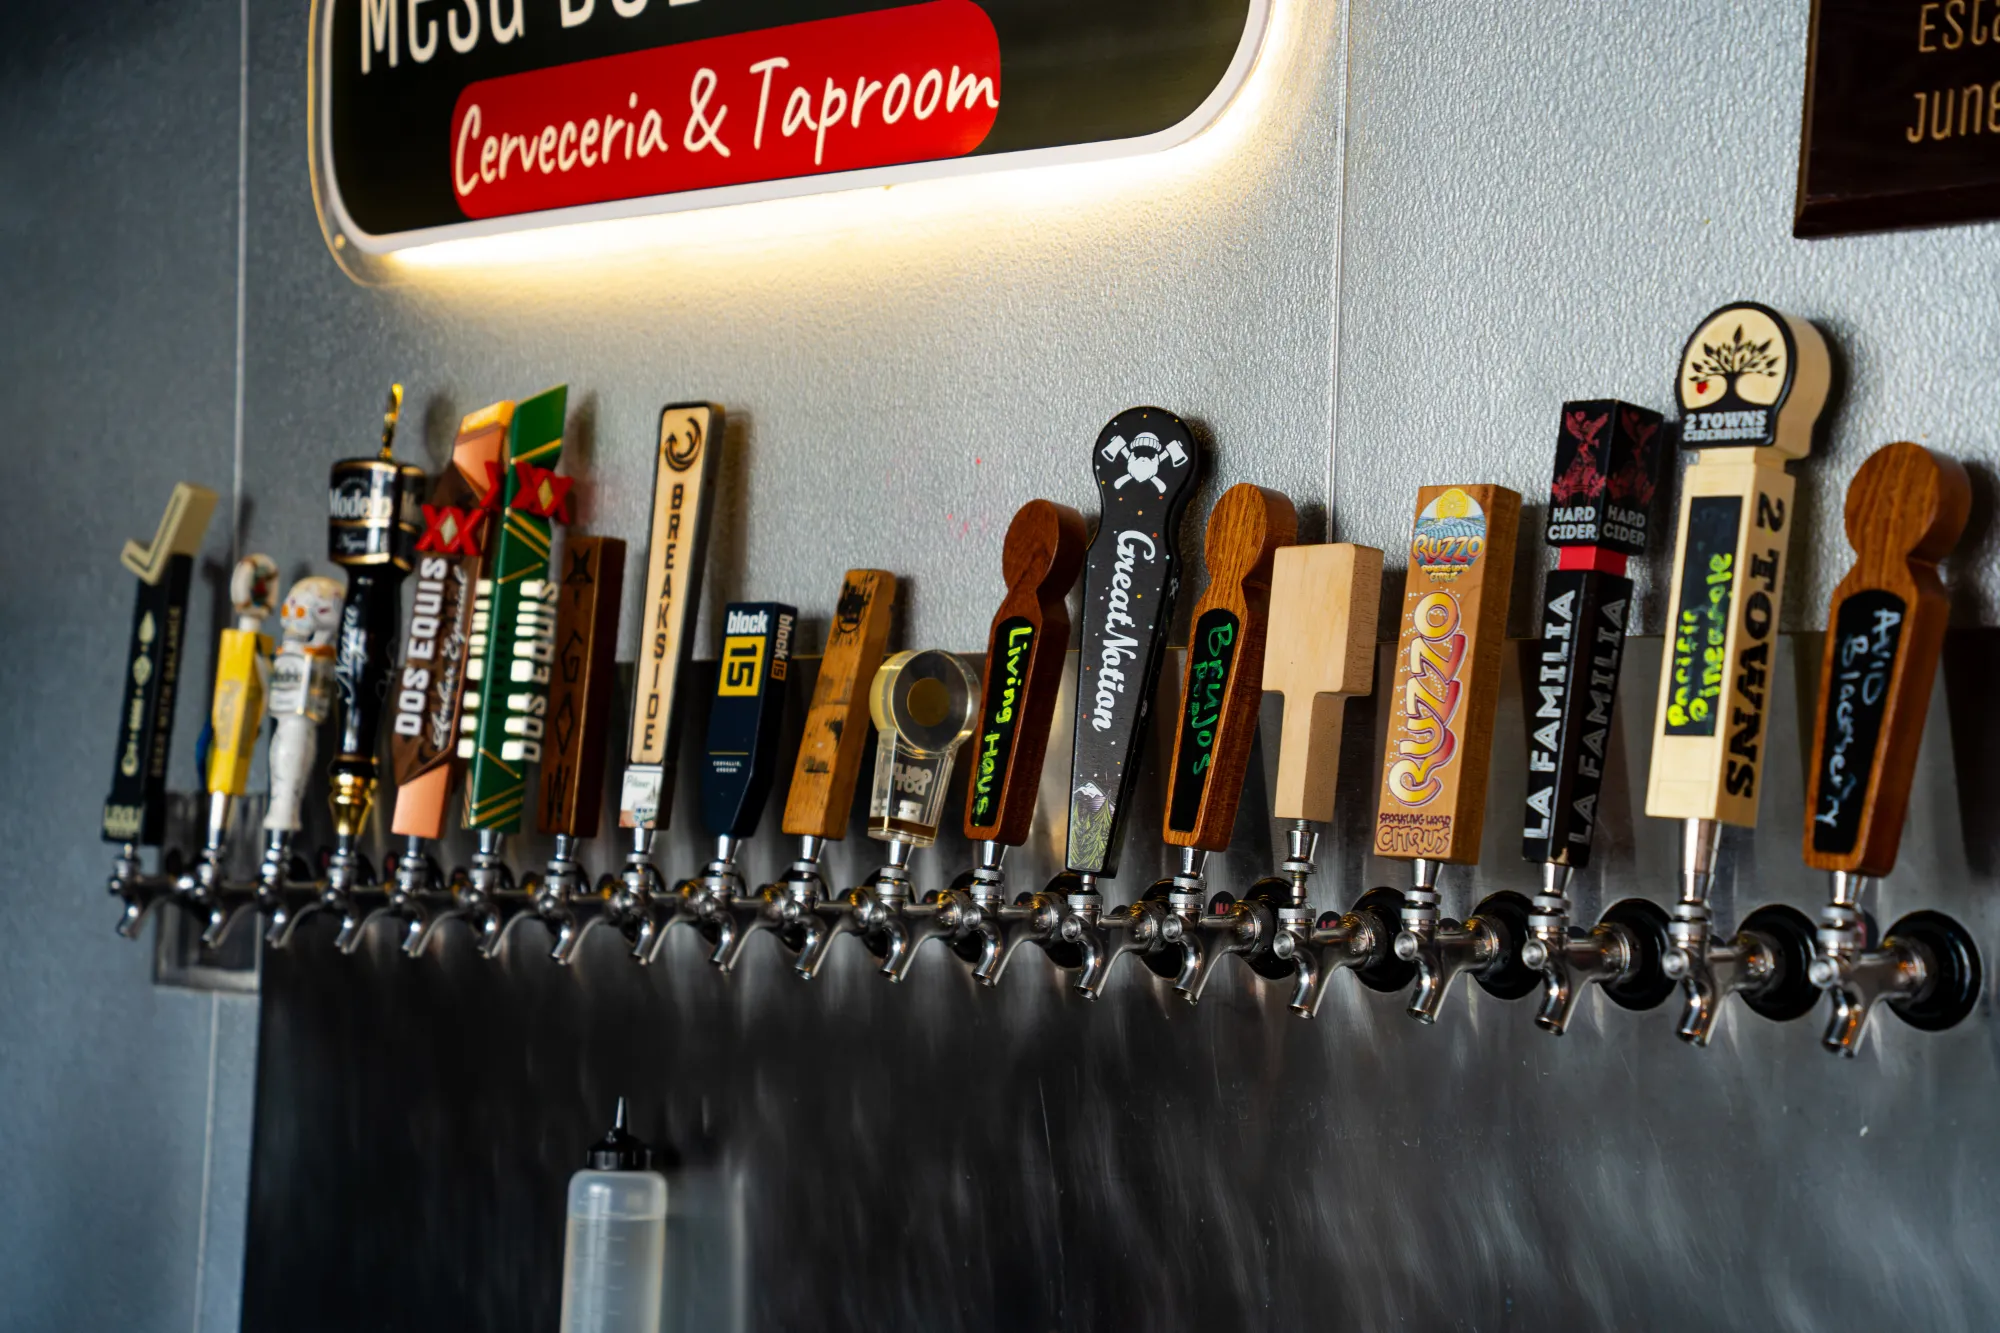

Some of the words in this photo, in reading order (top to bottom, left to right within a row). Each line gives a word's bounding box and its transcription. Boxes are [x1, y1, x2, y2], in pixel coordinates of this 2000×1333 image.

[455, 92, 669, 197] Cerveceria
[683, 68, 731, 158] &
[750, 57, 999, 166] Taproom
[1684, 413, 1697, 430] 2
[1698, 410, 1768, 429] TOWNS
[1548, 523, 1596, 541] CIDER
[1552, 506, 1596, 523] HARD
[1602, 523, 1645, 547] CIDER
[1607, 507, 1646, 527] HARD
[1755, 491, 1785, 532] 2
[1412, 533, 1485, 564] RUZZO
[407, 557, 448, 660] EQUIS
[643, 483, 685, 751] BREAKSIDE
[727, 610, 769, 634] block
[774, 613, 794, 661] block
[726, 643, 757, 687] 15
[773, 662, 785, 678] 15
[995, 626, 1033, 725] Living
[1530, 590, 1576, 773] FAMILIA
[1577, 598, 1627, 779] FAMILIA
[1725, 549, 1780, 799] TOWNS
[395, 667, 431, 737] DOS
[1388, 590, 1468, 807] RUZZO
[1523, 785, 1553, 839] LA
[1568, 793, 1596, 845] LA
[1376, 824, 1451, 856] CITRUS
